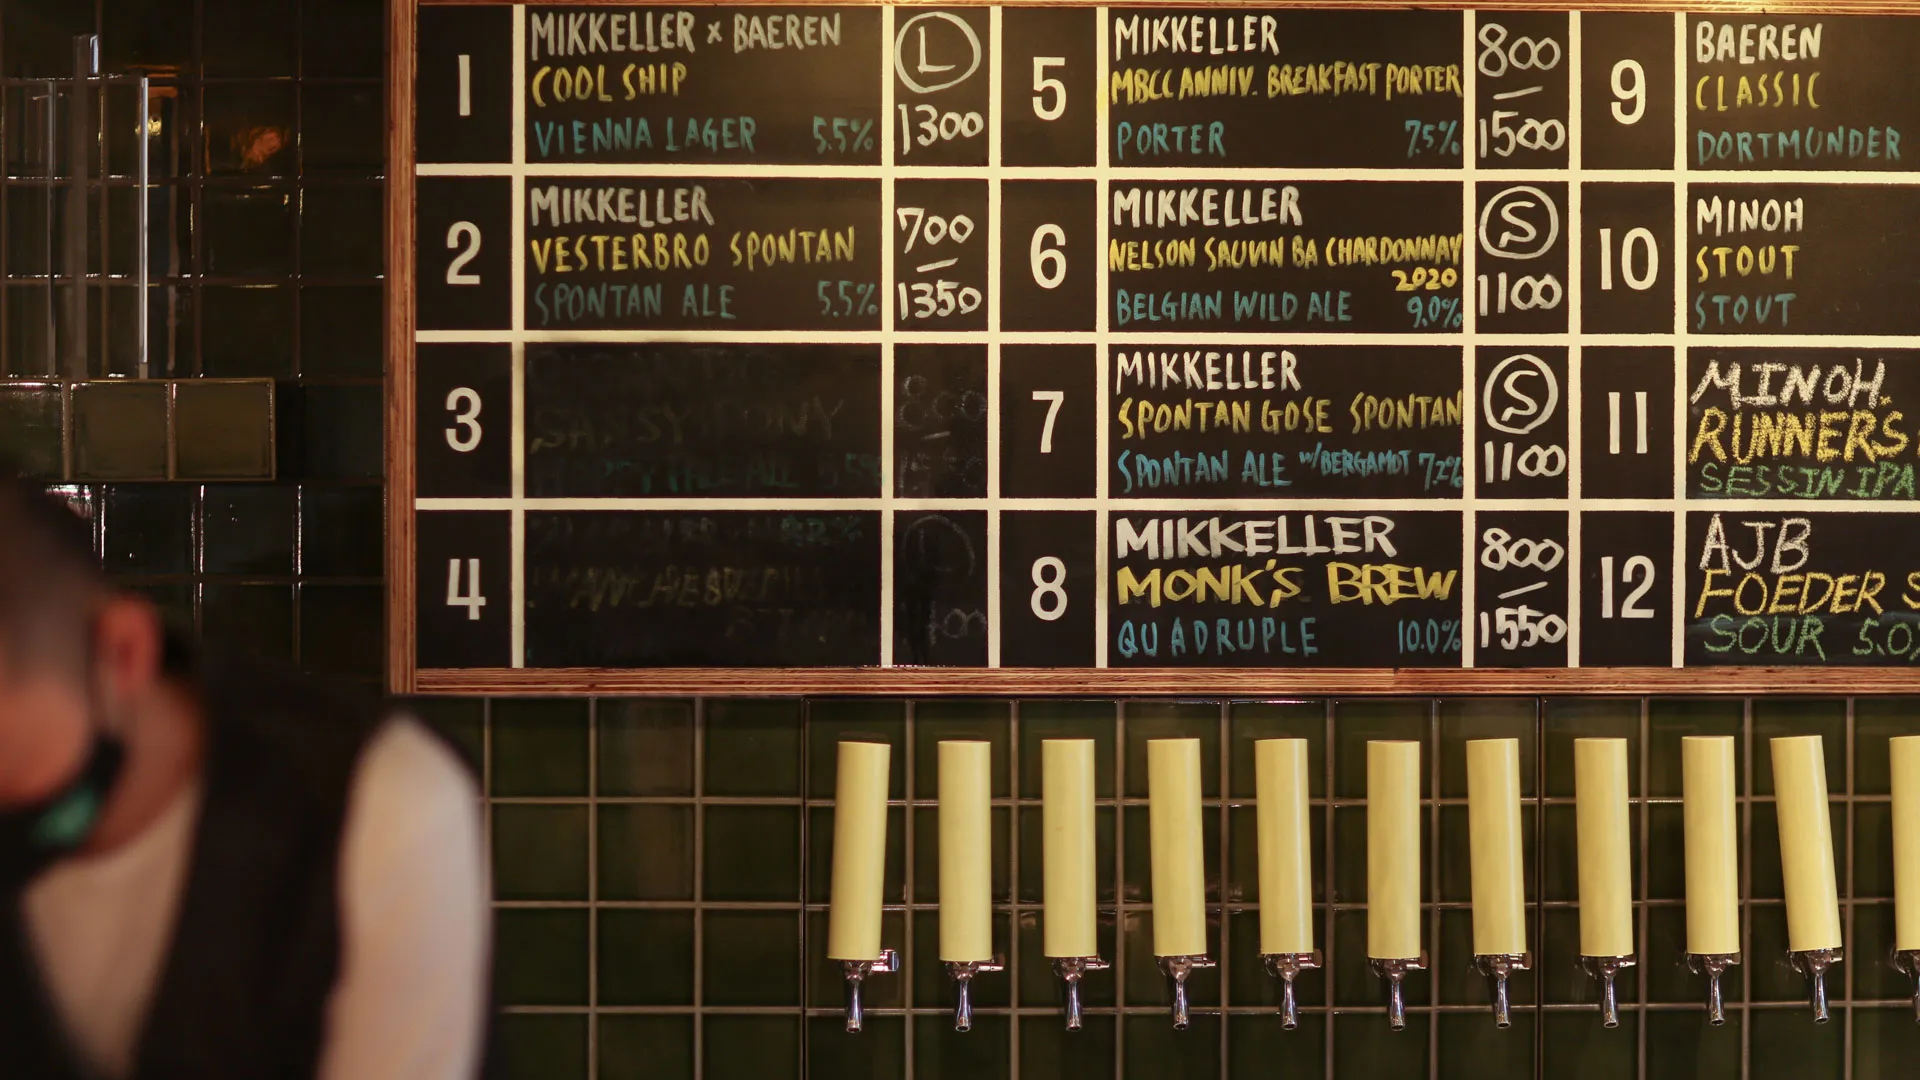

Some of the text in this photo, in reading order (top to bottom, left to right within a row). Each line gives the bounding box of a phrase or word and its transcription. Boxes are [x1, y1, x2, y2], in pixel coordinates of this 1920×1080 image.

[532, 11, 695, 61] MIKKELLER
[734, 13, 841, 53] BAEREN
[1115, 15, 1279, 61] MIKKELLER
[1478, 23, 1561, 77] 800
[1696, 21, 1822, 64] BAEREN
[532, 62, 686, 107] COOL SHIP
[1033, 57, 1066, 120] 5
[1111, 61, 1463, 104] MBCC ANNIV. BREAKFAST PORTER
[1611, 59, 1646, 125] 9
[1696, 71, 1819, 111] CLASSIC
[535, 113, 875, 156] VIENNA LAGER 5.5%
[898, 104, 984, 155] 1300
[1118, 121, 1225, 160] PORTER
[1479, 110, 1565, 158] 1500
[1698, 125, 1899, 165] DORTMUNDER
[531, 186, 714, 228] MIKKELLER
[1114, 186, 1302, 228] MIKKELLER
[1697, 196, 1803, 236] MINOH
[531, 226, 854, 273] VESTERBRO SPONTAN
[896, 207, 974, 253] 700
[1109, 238, 1195, 271] NELSON
[1292, 235, 1318, 267] BA
[1326, 233, 1463, 266] CHARDONNAY
[446, 221, 481, 285] 2
[1030, 224, 1066, 289] 6
[1600, 227, 1658, 290] 10
[1696, 245, 1799, 282] STOUT
[898, 279, 982, 320] 1350
[1392, 267, 1457, 291] 2020
[1477, 273, 1562, 316] 1100
[535, 279, 879, 327] SPONTAN ALE 5.5%
[1117, 289, 1462, 330] BELGIAN WILD ALE 9.0%
[1695, 292, 1796, 330] STOUT
[1116, 350, 1301, 394] MIKKELLER
[445, 387, 482, 452] 3
[1032, 391, 1064, 453] 7
[1118, 391, 1463, 439] SPONTAN GOSE SPONTAN
[1609, 392, 1647, 454] 11
[1118, 450, 1227, 493] SPONTAN
[1242, 450, 1291, 486] ALE
[1485, 441, 1566, 483] 1100
[1846, 460, 1914, 499] IPA
[1116, 515, 1397, 560] MIKKELLER
[1481, 528, 1564, 571] 800
[1700, 513, 1812, 576] AJB
[446, 558, 486, 620] 4
[1031, 556, 1067, 621] 8
[1117, 559, 1457, 608] MONK'S BREW
[1601, 555, 1655, 618] 12
[1695, 568, 1885, 619] FOEDER
[1399, 618, 1461, 654] 10.0%
[1480, 606, 1569, 651] 1550
[1703, 613, 1825, 661] SOUR
